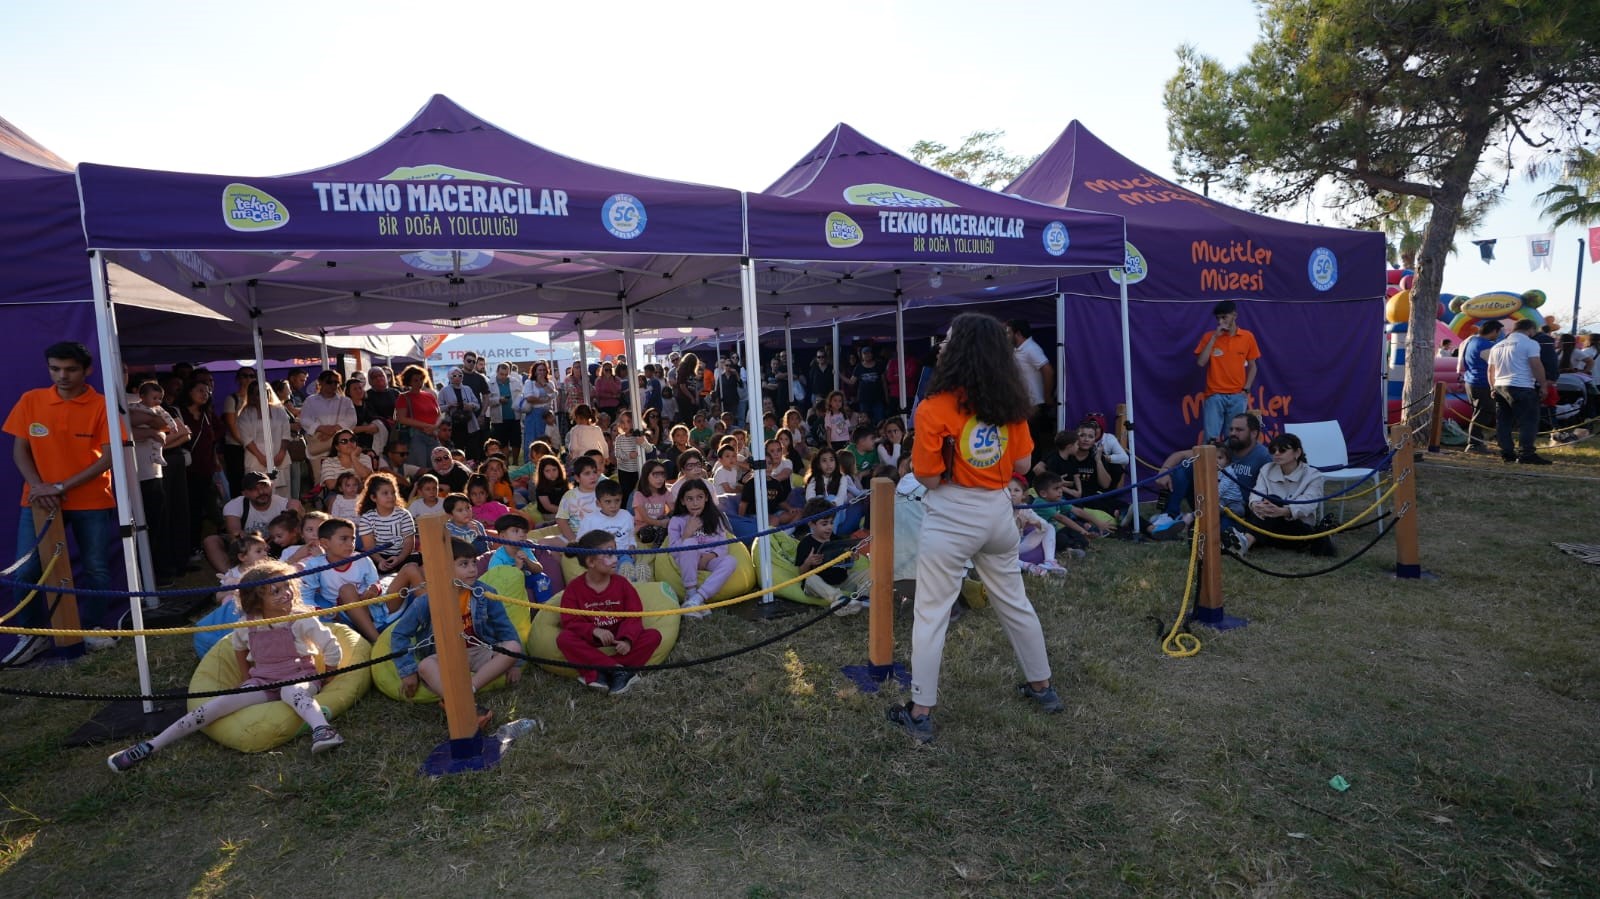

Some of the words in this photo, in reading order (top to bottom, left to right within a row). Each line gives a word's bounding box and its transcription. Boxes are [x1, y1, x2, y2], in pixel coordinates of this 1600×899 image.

[234, 195, 276, 213] tekno
[313, 182, 402, 212] TEKNO
[407, 183, 569, 216] MACERACILAR
[232, 209, 282, 222] macera
[378, 213, 398, 235] BİR
[405, 214, 442, 235] DOĞA
[448, 214, 518, 236] YOLCULUĞU
[879, 211, 928, 234] TEKNO
[931, 213, 1025, 239] MACERACILAR
[913, 235, 925, 252] BİR
[929, 236, 950, 252] DOĞA
[954, 237, 995, 254] YOLCULUĞU
[1191, 240, 1273, 265] Mucitler
[1201, 269, 1264, 292] Müzesi
[448, 351, 465, 360] TR
[477, 348, 530, 358] MARKET
